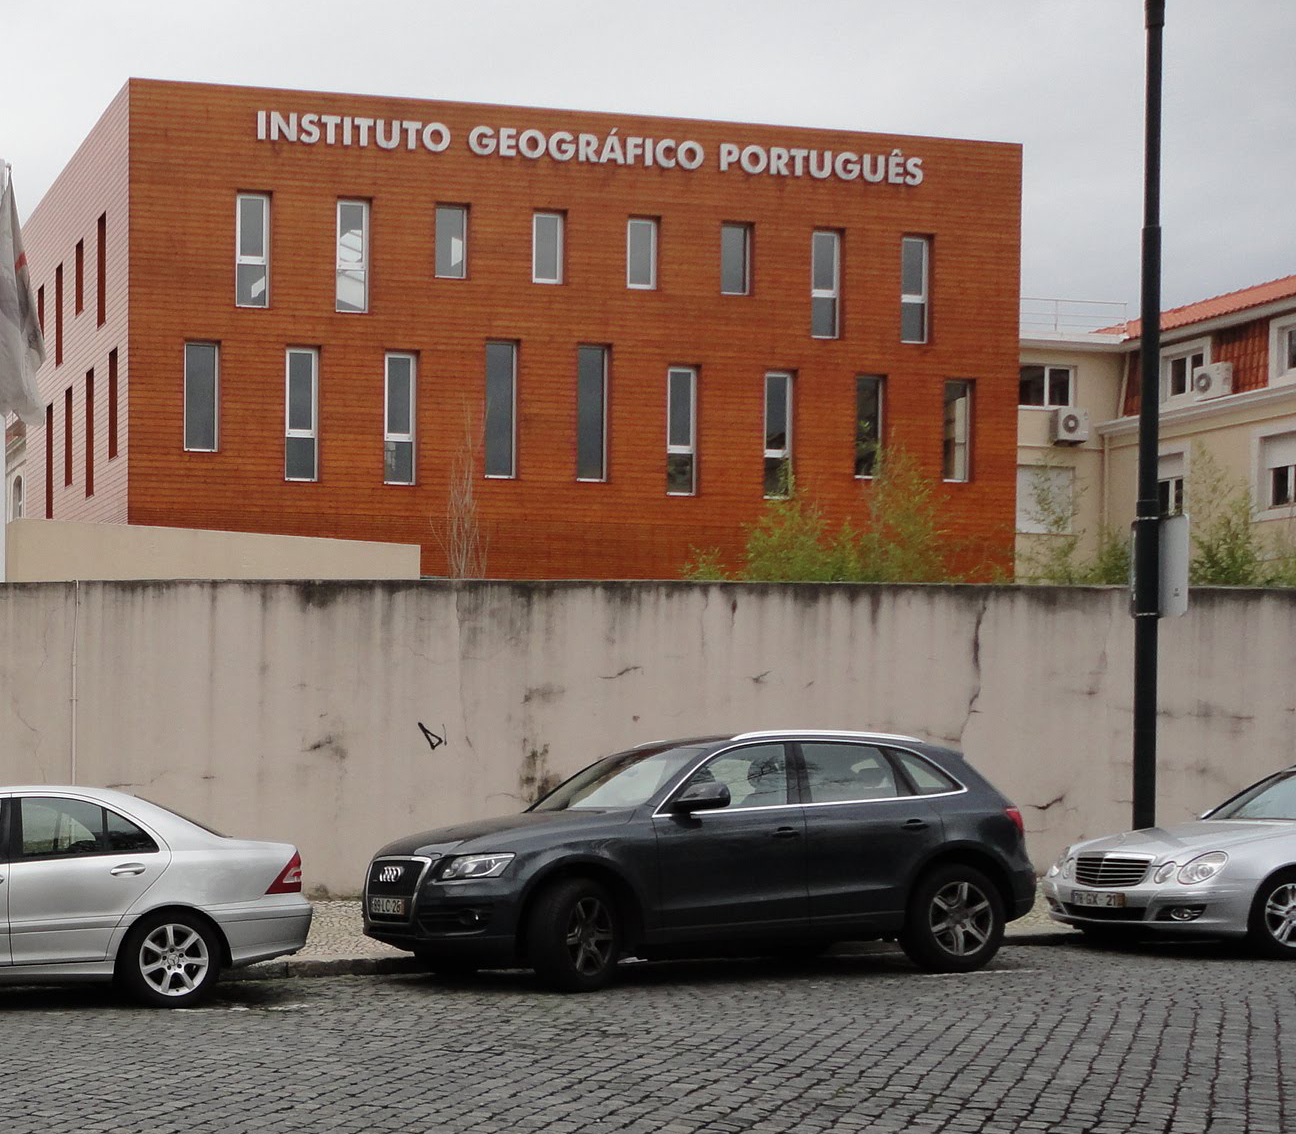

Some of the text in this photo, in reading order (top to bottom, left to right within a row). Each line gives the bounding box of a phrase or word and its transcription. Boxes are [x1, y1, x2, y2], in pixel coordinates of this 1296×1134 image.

[256, 109, 924, 187] INSTITUTO GEOGRÁFICO PORTUGUÊS
